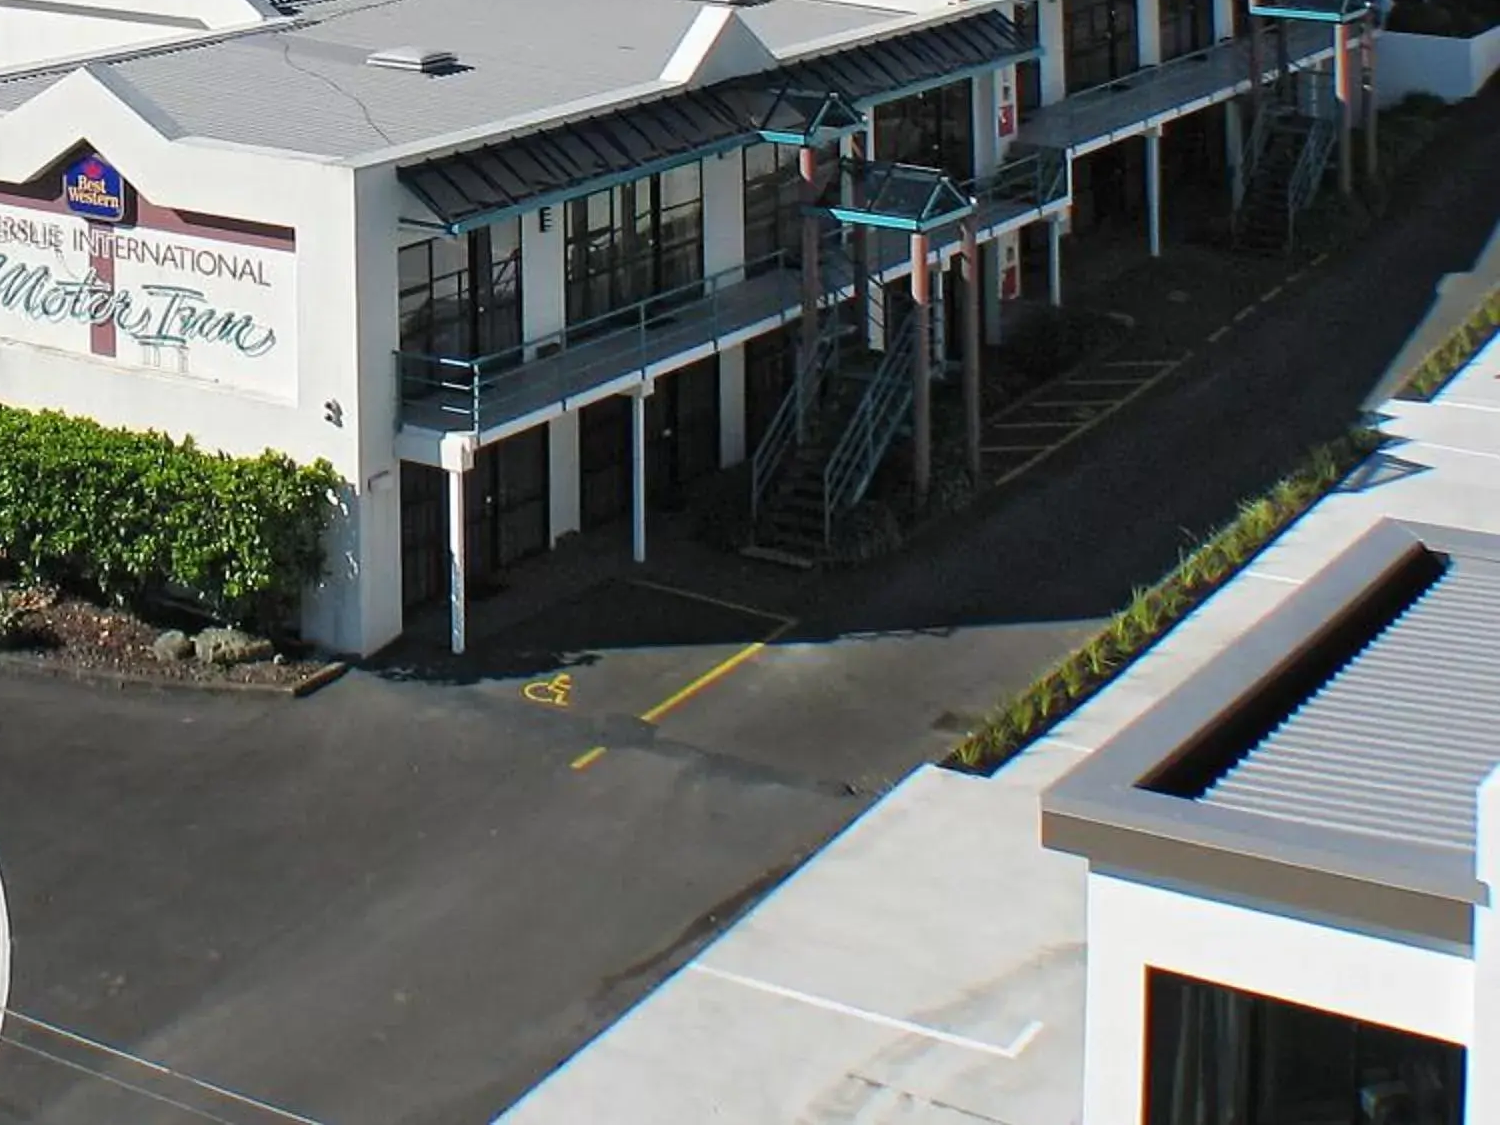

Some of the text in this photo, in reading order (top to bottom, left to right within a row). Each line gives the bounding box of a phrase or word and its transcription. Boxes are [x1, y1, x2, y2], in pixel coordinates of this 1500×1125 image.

[77, 174, 107, 194] Best
[67, 186, 119, 208] Western
[73, 226, 272, 288] INTERNATIONAL
